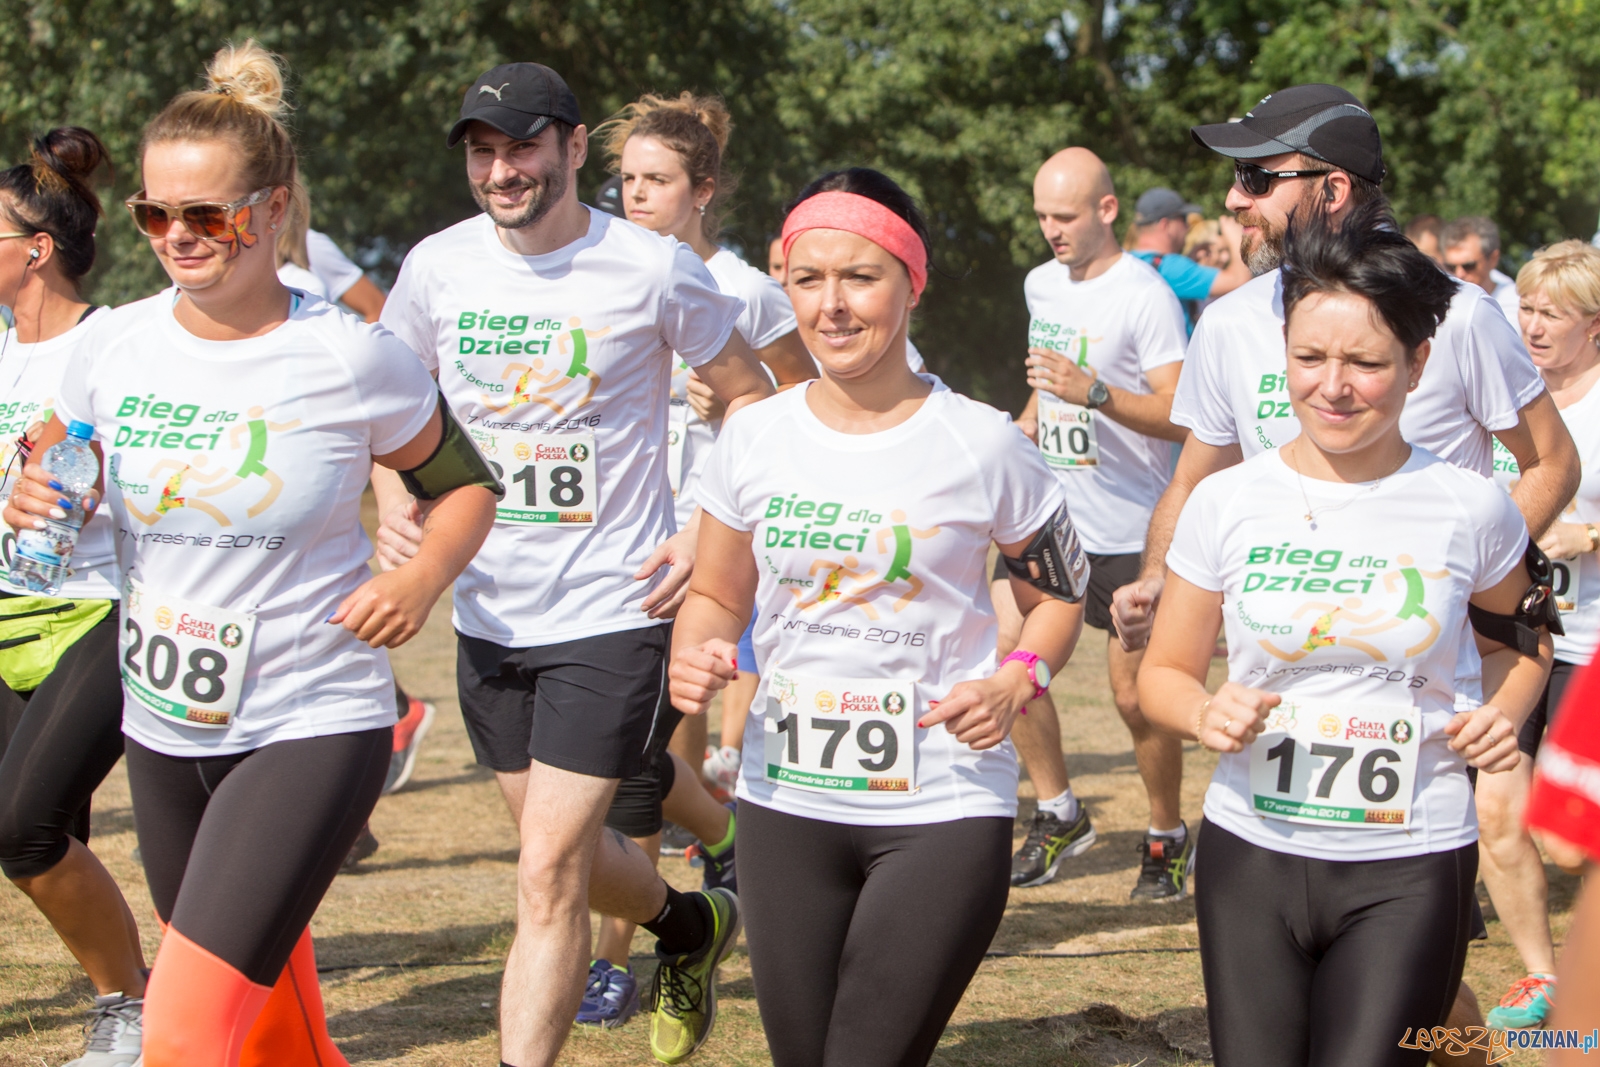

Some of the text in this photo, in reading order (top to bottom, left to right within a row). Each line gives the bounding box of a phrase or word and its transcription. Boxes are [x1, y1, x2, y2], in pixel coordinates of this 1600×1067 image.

[458, 309, 562, 336] Bieg dla
[459, 334, 552, 355] Dzieci
[454, 360, 504, 393] Roberta
[1258, 370, 1289, 394] Bi
[0, 401, 40, 419] eg dla
[115, 393, 239, 427] Bieg dla
[0, 415, 31, 435] eci
[467, 414, 601, 432] 7 września 2016
[114, 424, 224, 450] Dzieci
[1041, 421, 1089, 455] 210
[535, 452, 568, 462] POLSKA
[536, 444, 566, 453] CHATA
[1493, 457, 1520, 473] zie
[522, 513, 547, 521] 2016
[765, 493, 882, 526] Bieg dla
[119, 528, 128, 542] 7
[215, 534, 286, 550] 2016
[765, 523, 870, 553] Dzieci
[1245, 542, 1388, 573] Bieg dla
[764, 555, 815, 588] Roerta
[1242, 570, 1376, 594] Dzieci
[180, 613, 216, 632] CHATA
[1236, 600, 1293, 635] Roberta
[176, 623, 216, 641] POLSKA
[864, 627, 926, 647] 2016
[124, 617, 228, 704] 208
[840, 702, 881, 714] POLSKA
[842, 691, 878, 704] CHATA
[1345, 728, 1387, 740] POLSKA
[1348, 717, 1385, 731] CHATA
[777, 712, 899, 772] 179
[778, 769, 788, 779] 17
[824, 777, 854, 788] 2016
[1266, 737, 1401, 803] 176
[1263, 801, 1275, 810] 17
[1317, 808, 1350, 819] 2016
